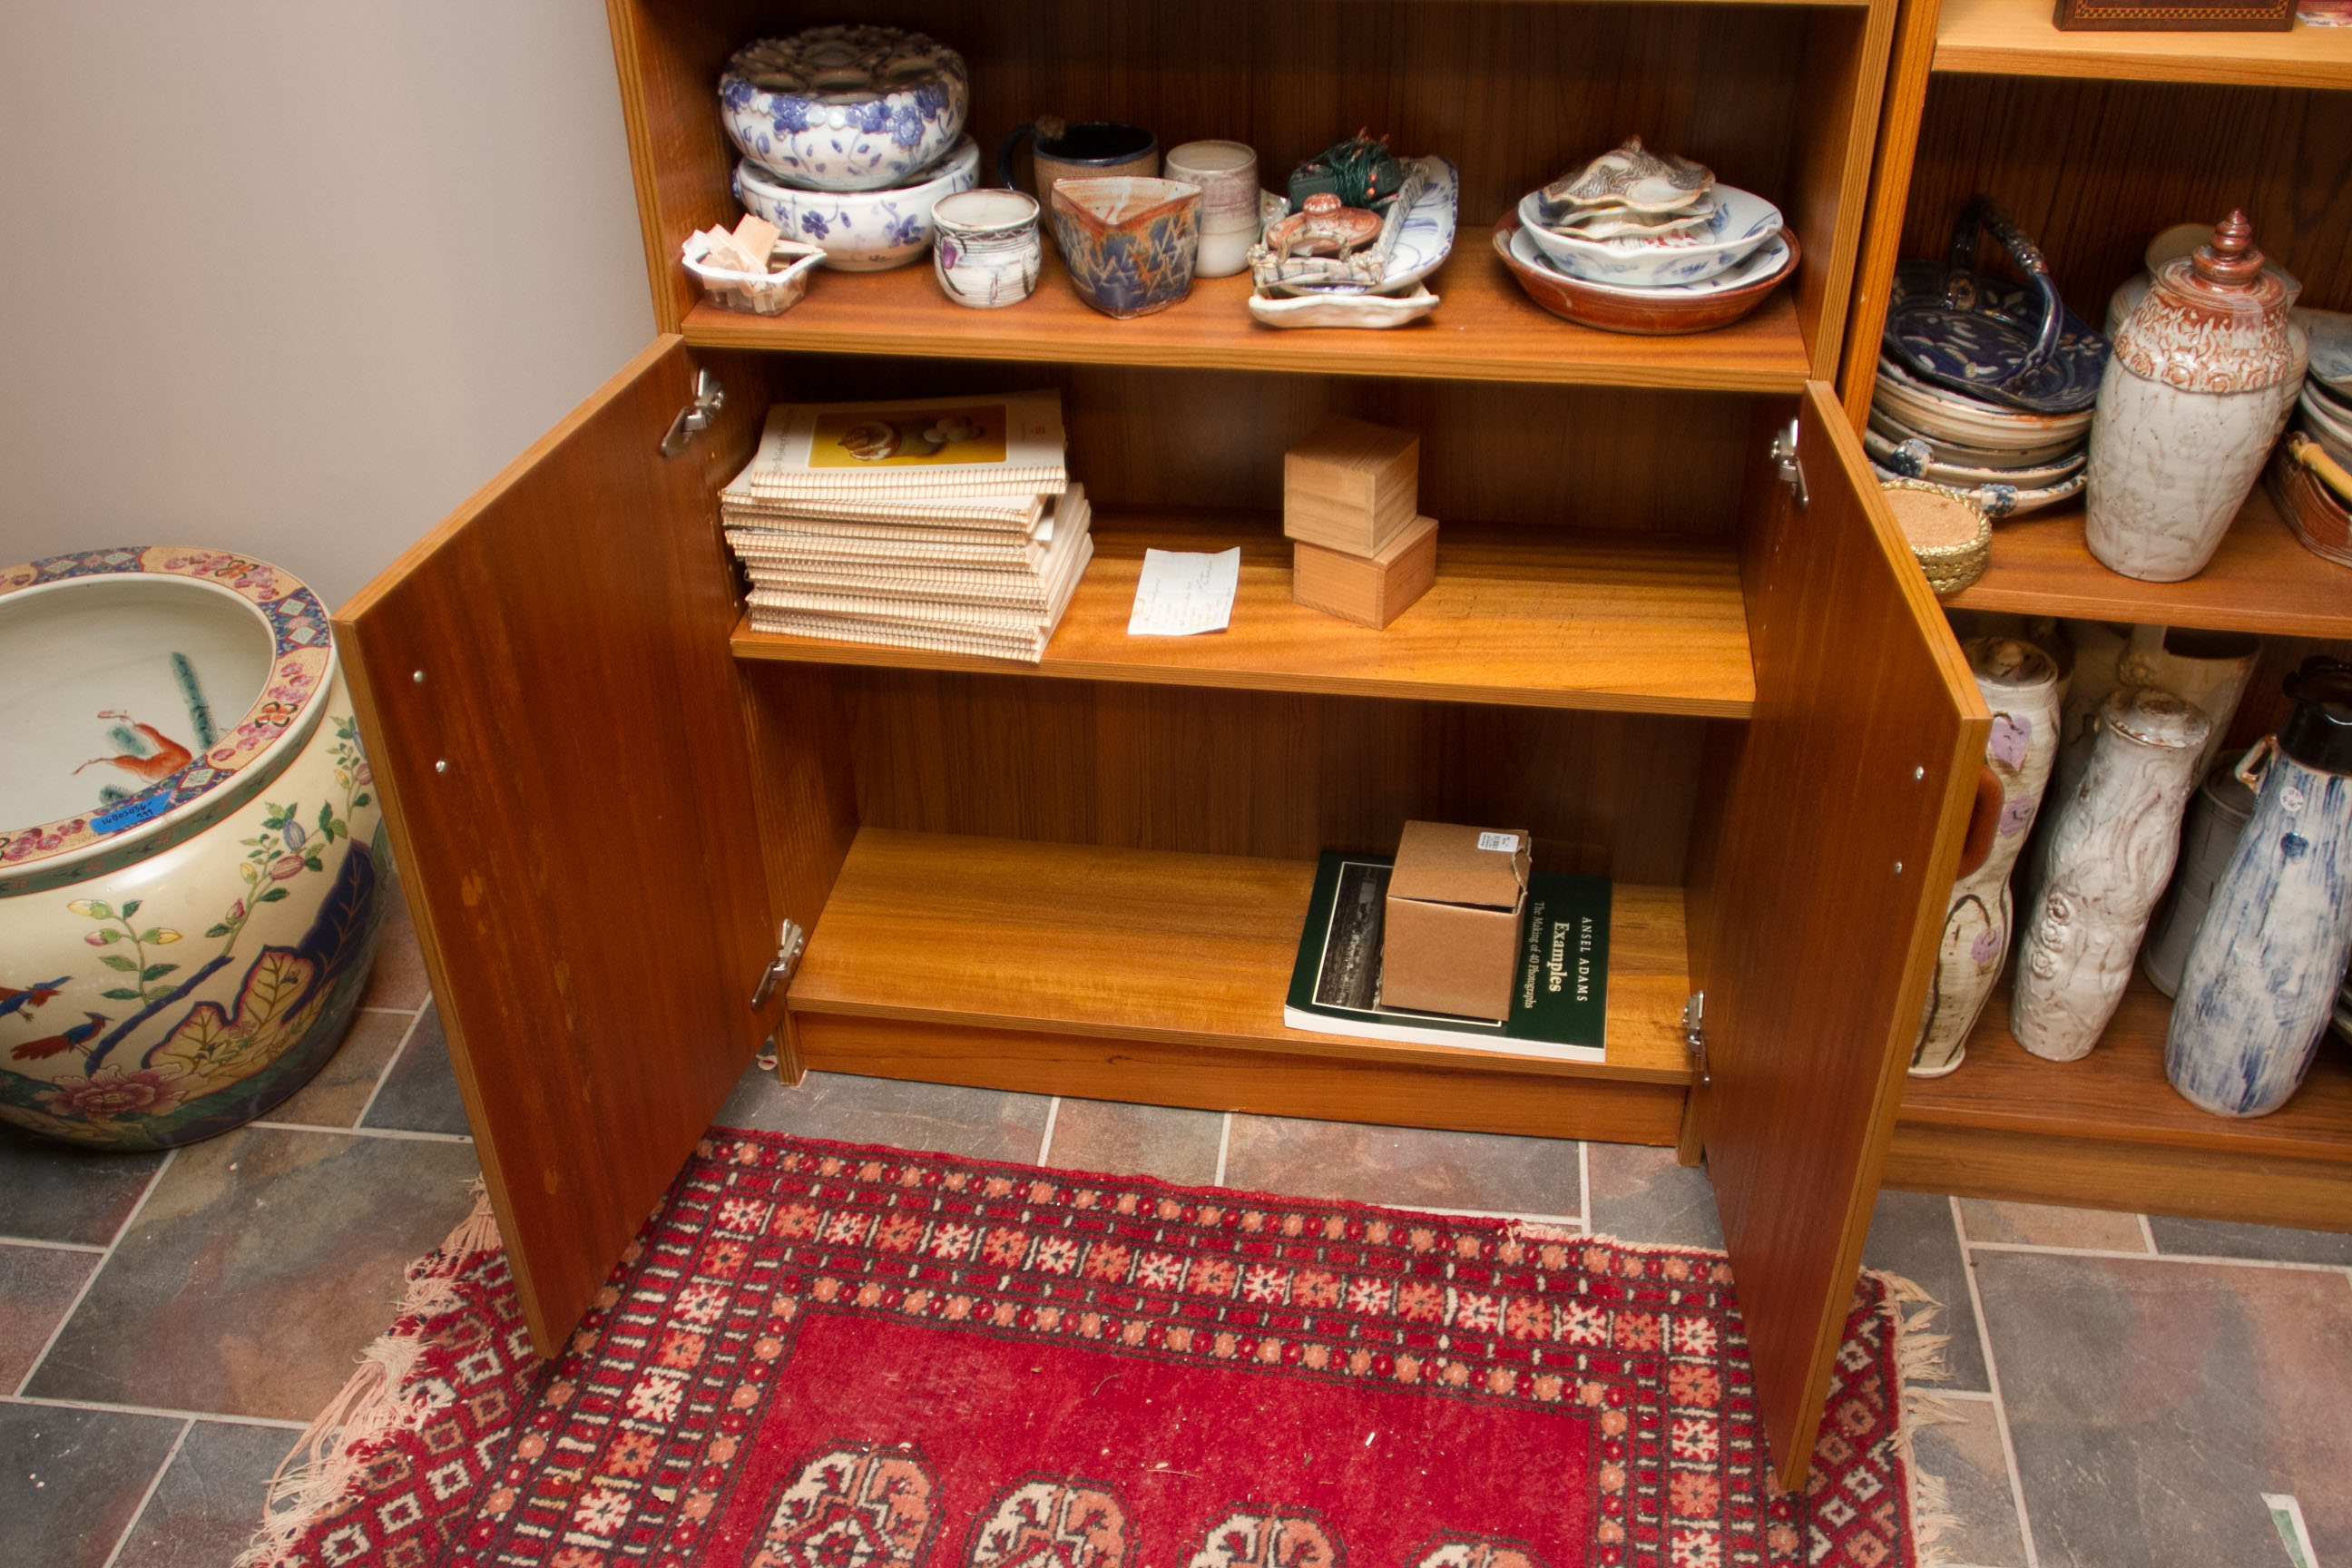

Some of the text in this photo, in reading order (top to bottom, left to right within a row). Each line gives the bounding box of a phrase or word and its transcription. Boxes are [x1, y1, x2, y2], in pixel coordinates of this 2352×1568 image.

[1524, 901, 1544, 1008] The Making of 40 Photographs
[1547, 922, 1570, 992] Examples
[1577, 916, 1592, 1002] ANSEL ADAMS
